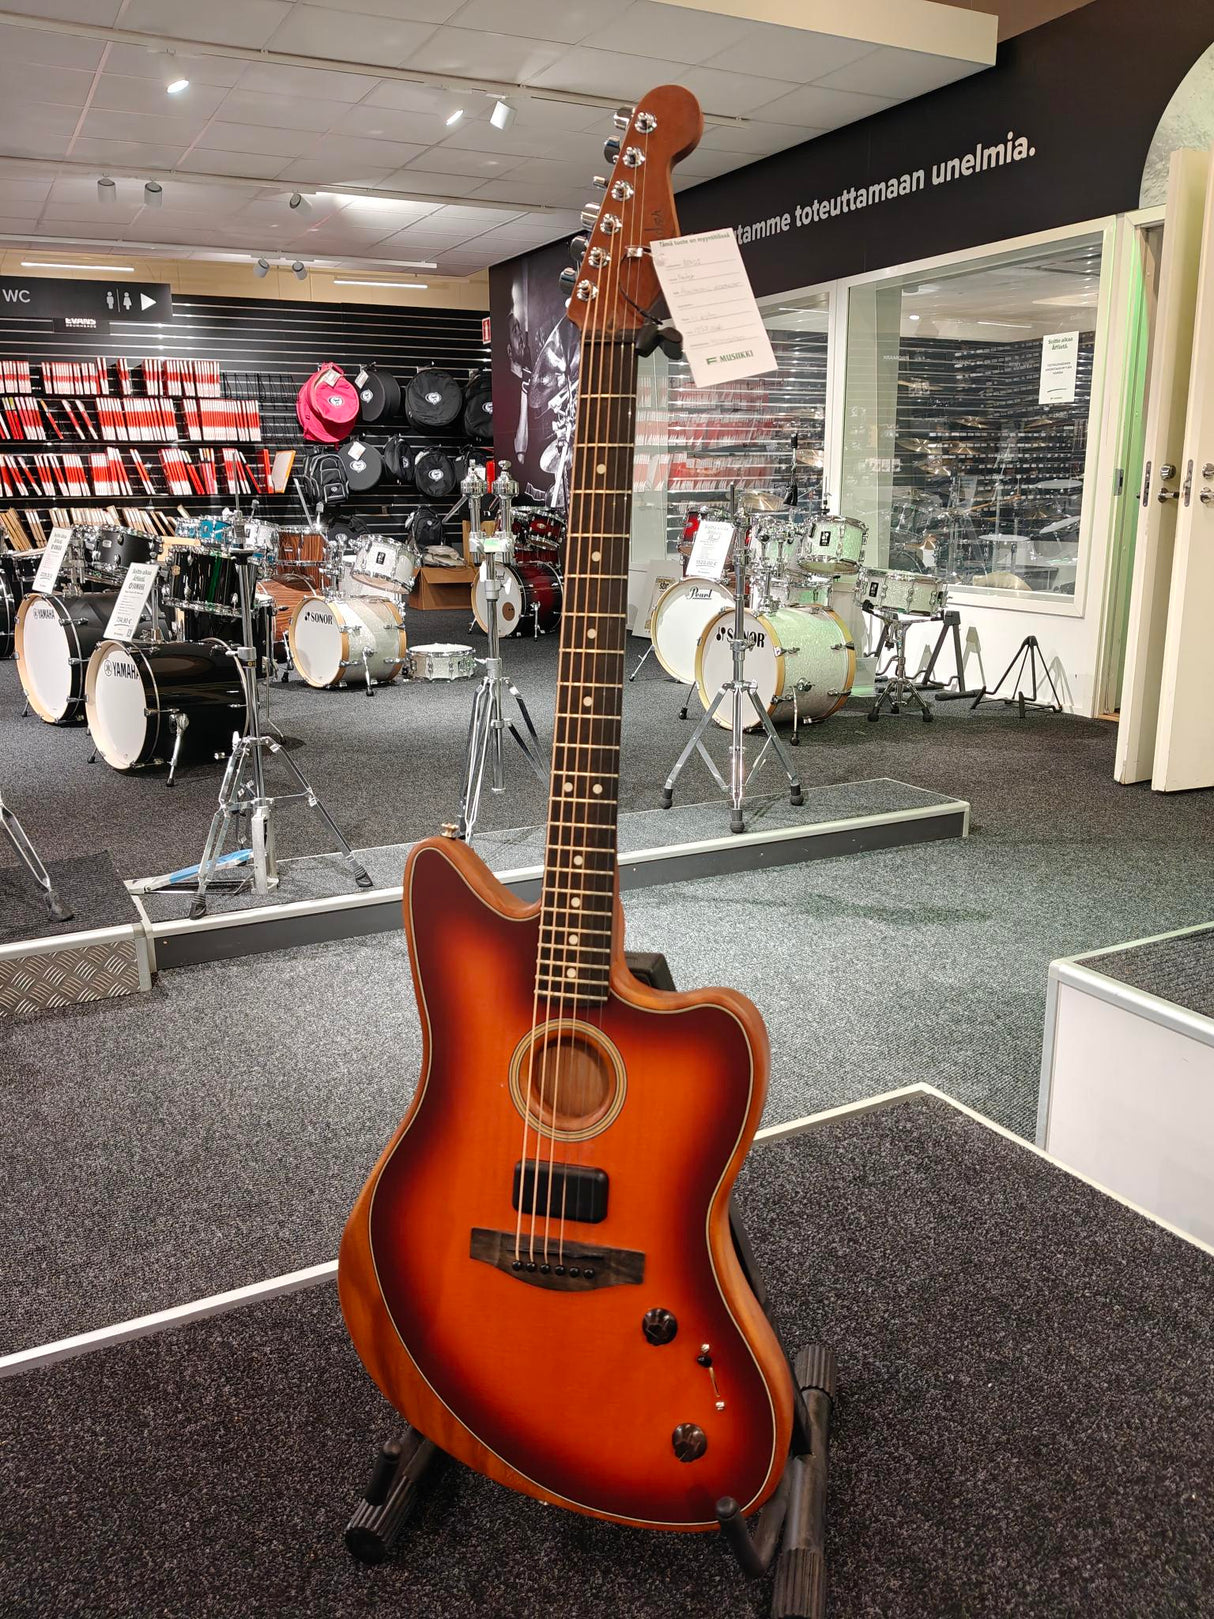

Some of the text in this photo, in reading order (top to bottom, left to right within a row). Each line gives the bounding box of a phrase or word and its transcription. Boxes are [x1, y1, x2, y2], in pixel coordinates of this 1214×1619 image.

[734, 131, 1036, 245] tamme toteuttamaan unelmia.
[2, 289, 31, 303] WC
[65, 317, 97, 325] EVANS
[719, 350, 754, 362] MUSIIKKI
[687, 586, 713, 600] Pearl
[38, 608, 55, 620] YAMAHA
[311, 612, 333, 625] SONOR
[727, 627, 765, 648] SNOR
